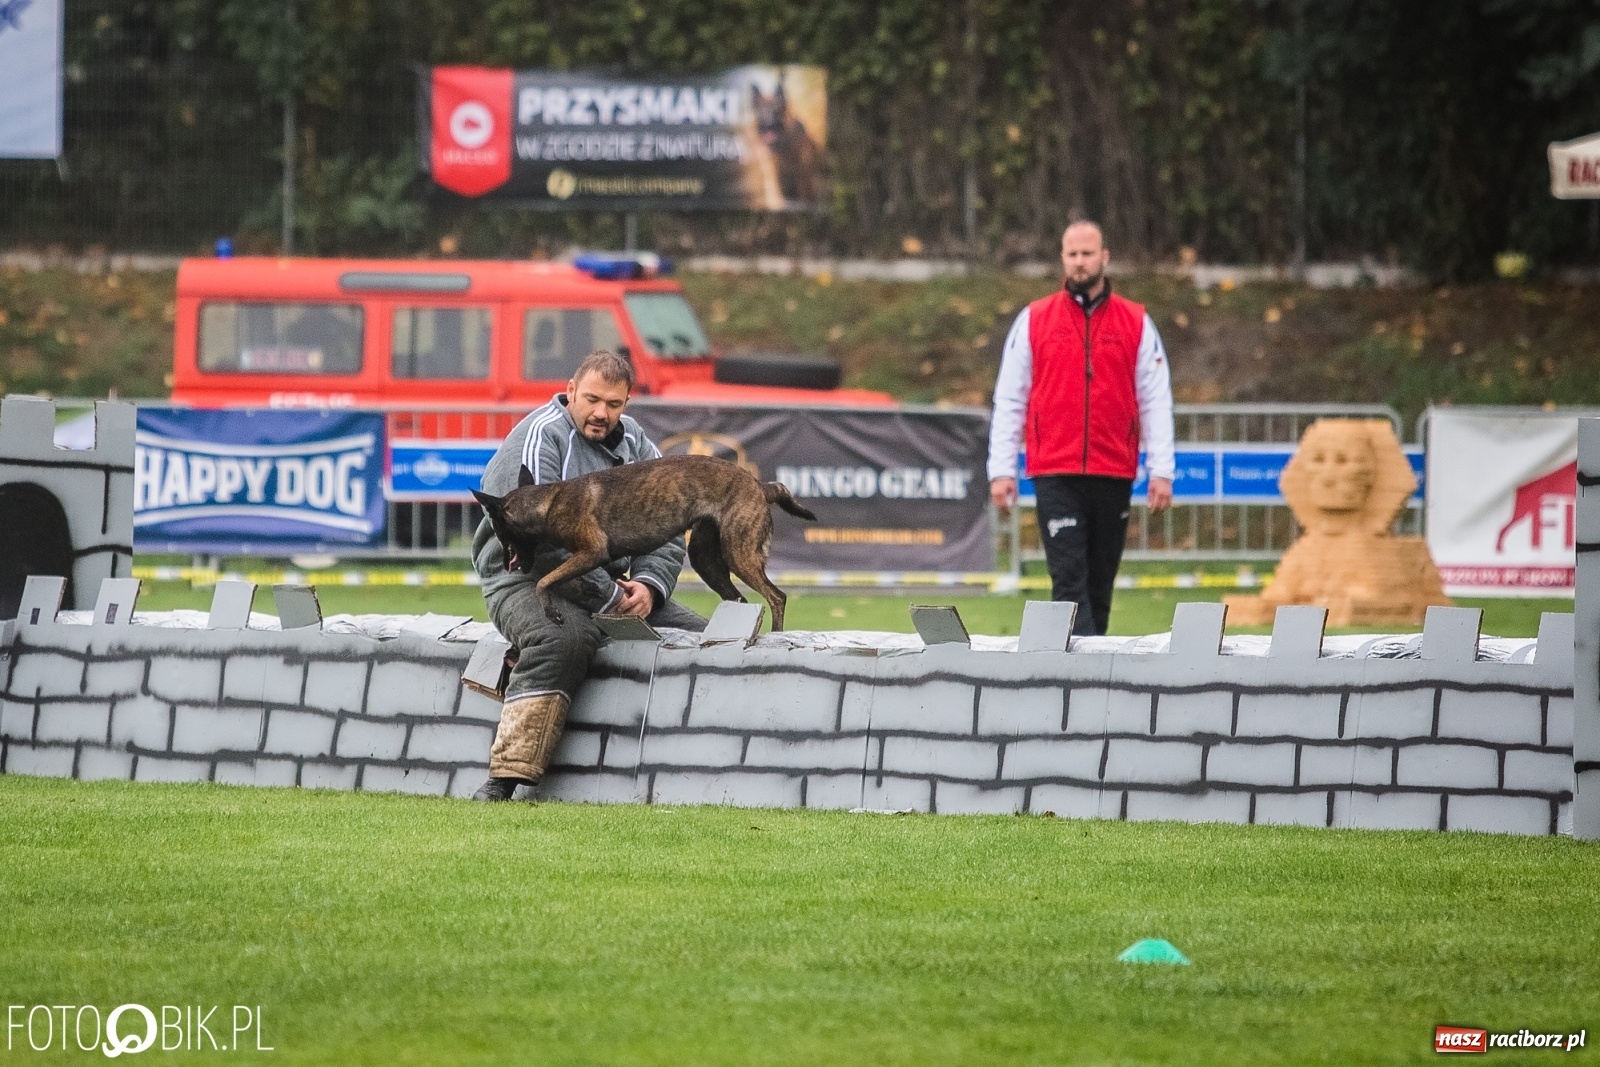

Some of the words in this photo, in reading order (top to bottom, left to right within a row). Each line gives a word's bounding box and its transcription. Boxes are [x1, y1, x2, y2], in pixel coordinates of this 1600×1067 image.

[518, 86, 740, 125] PRZYSMAKI
[134, 446, 272, 511] HAPPY
[275, 452, 366, 516] DOG
[777, 466, 877, 498] DINGO
[879, 468, 967, 499] GEAR
